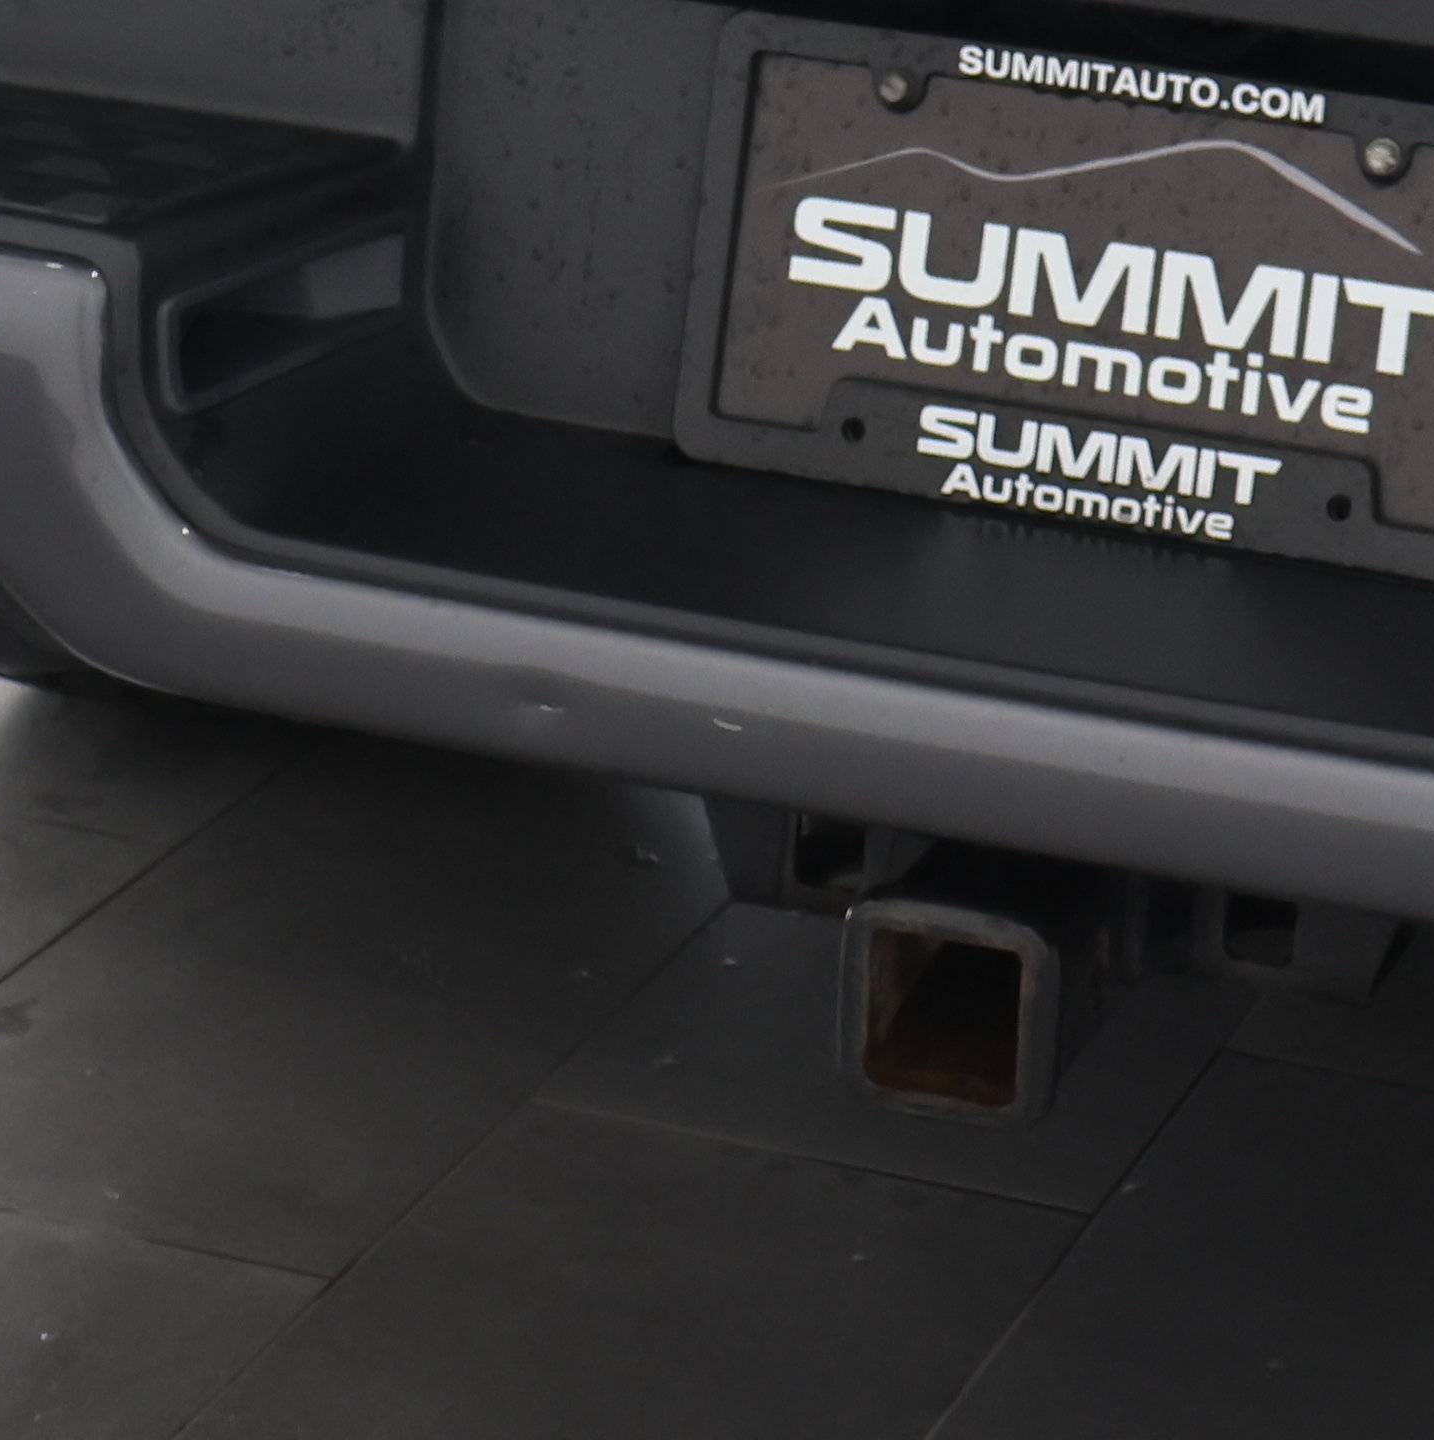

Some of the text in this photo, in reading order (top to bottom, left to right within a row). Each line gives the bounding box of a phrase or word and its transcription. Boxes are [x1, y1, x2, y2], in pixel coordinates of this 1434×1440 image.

[958, 44, 1326, 124] SUMMITAUTO.COM
[831, 295, 1375, 435] Automotive
[915, 404, 1284, 507] SUMMIT
[940, 463, 1235, 542] Automotive
